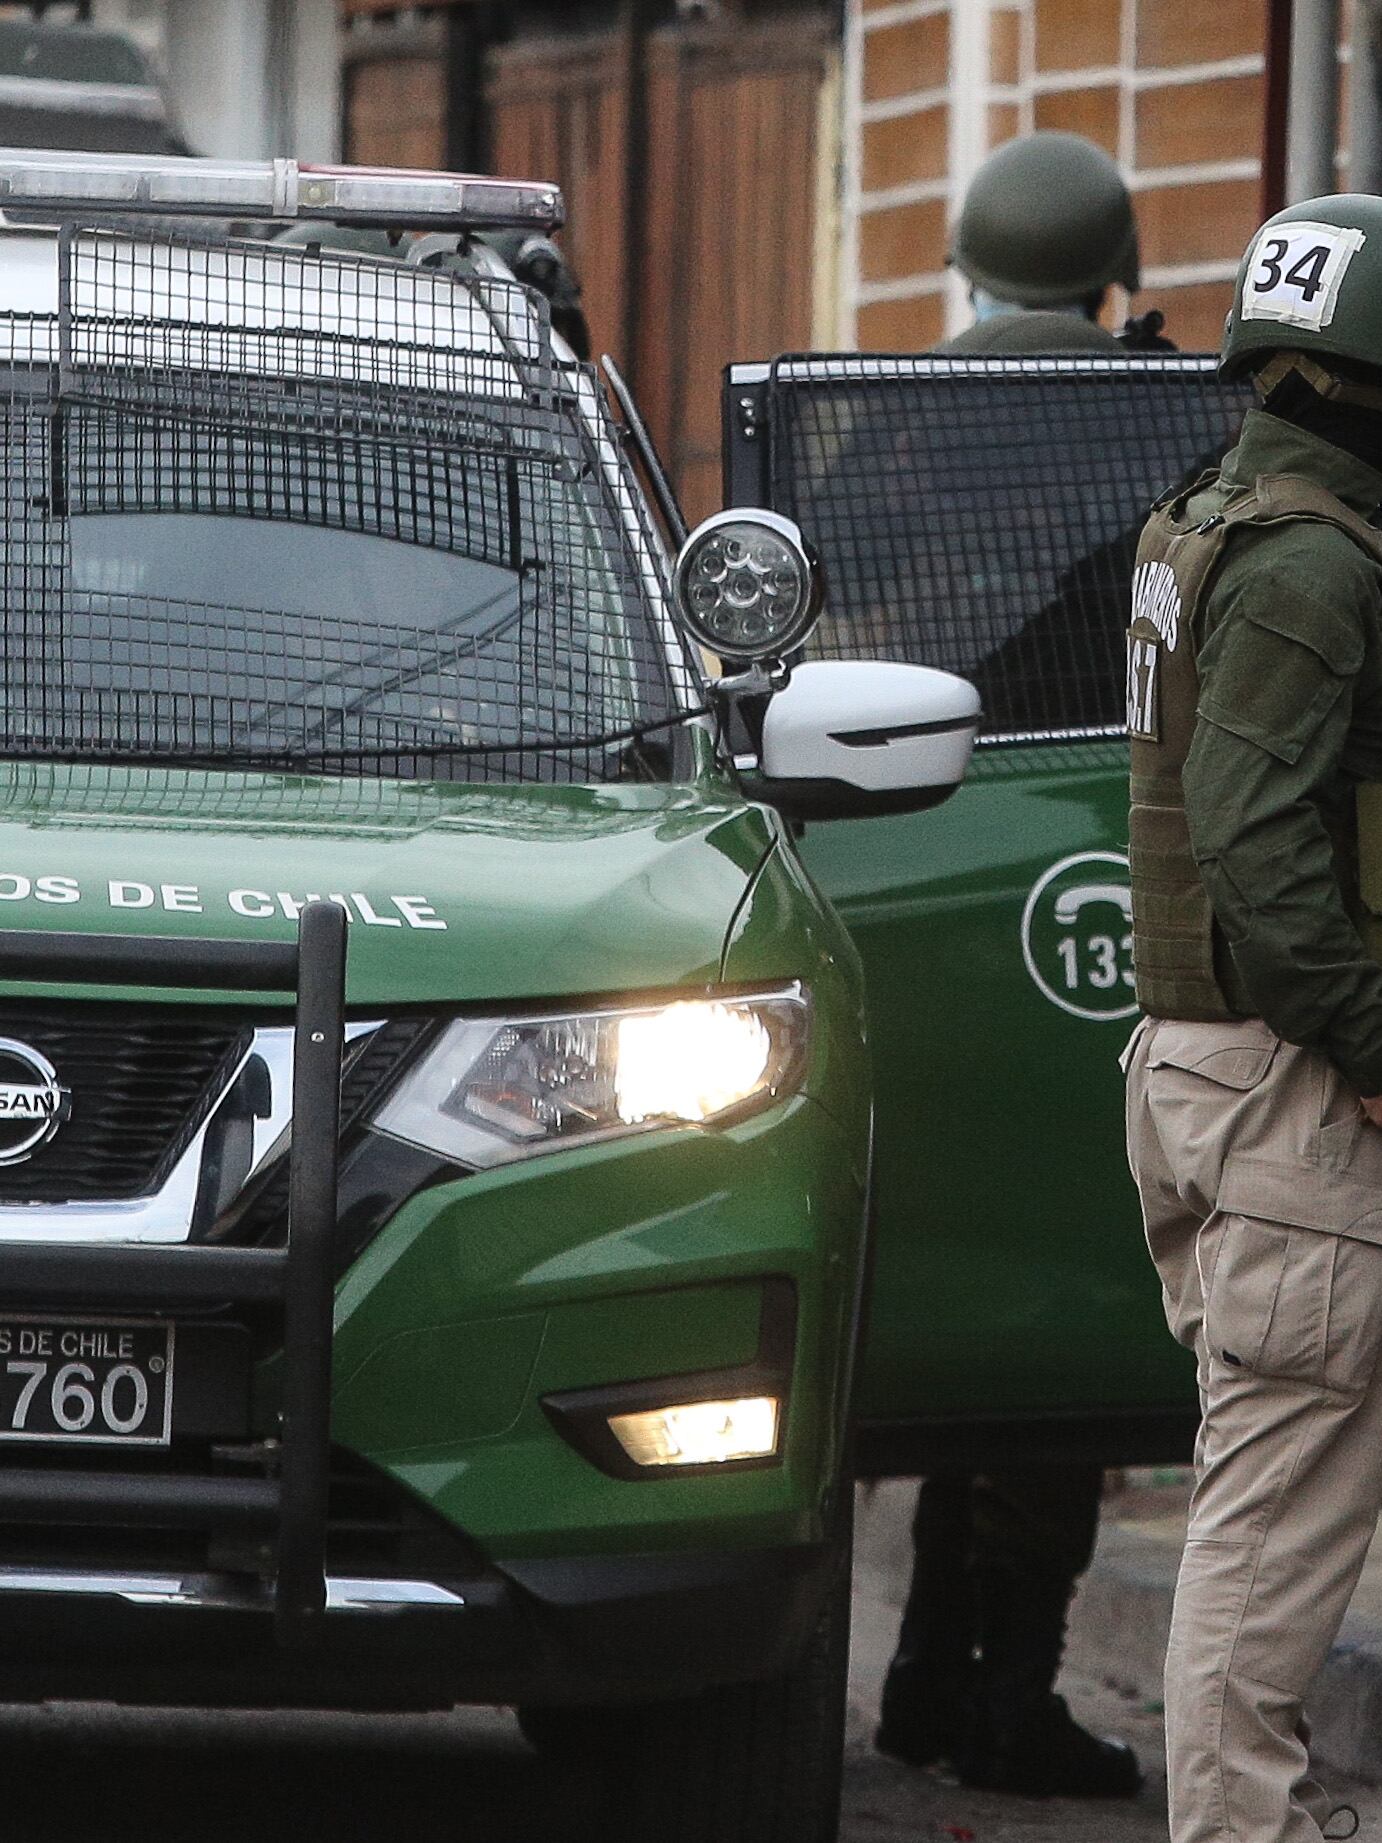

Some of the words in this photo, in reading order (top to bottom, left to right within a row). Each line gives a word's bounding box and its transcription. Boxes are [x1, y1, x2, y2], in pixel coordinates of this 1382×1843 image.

[1253, 239, 1331, 302] 34
[108, 880, 203, 912] DE
[20, 1330, 53, 1356] DE
[60, 1331, 134, 1359] CHILE
[7, 1362, 148, 1433] 760
